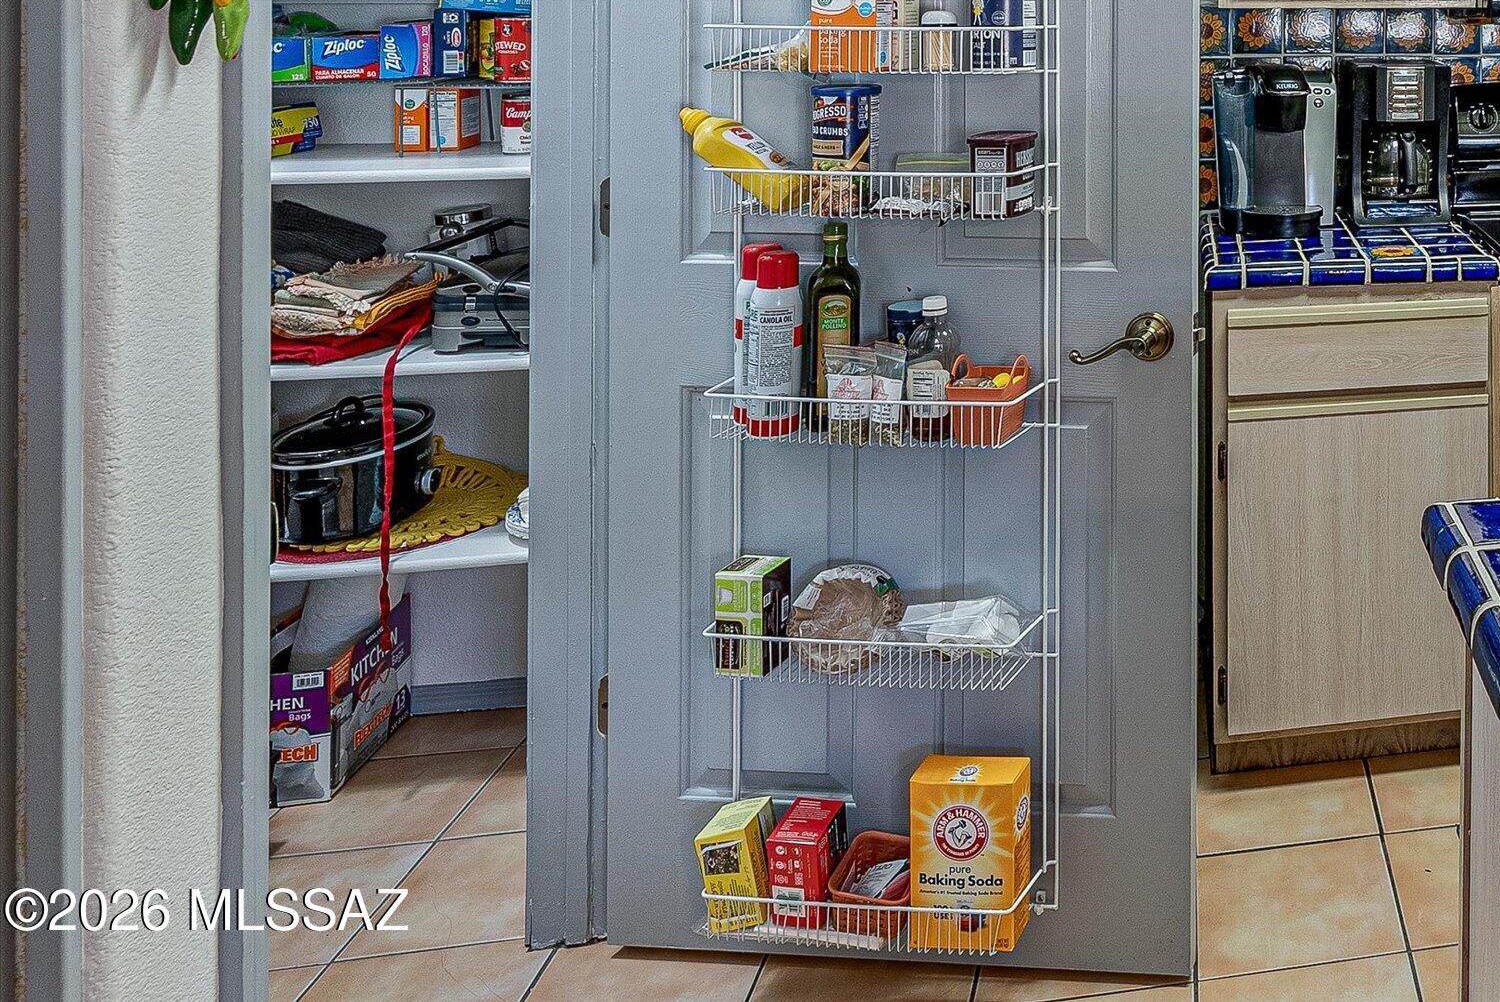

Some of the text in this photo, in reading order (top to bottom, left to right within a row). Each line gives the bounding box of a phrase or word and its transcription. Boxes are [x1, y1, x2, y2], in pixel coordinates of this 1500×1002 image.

[323, 39, 365, 56] Ziploc
[384, 35, 403, 71] Ziploc
[291, 73, 304, 81] 125
[366, 70, 377, 78] 50
[1275, 82, 1299, 90] KEURIG
[819, 126, 849, 137] CRUMBS
[760, 316, 783, 324] CANOLA
[350, 627, 398, 687] KITCHN
[288, 712, 312, 722] Bags
[936, 809, 986, 838] ARM & HAMMER
[949, 866, 972, 875] pure
[919, 873, 1004, 889] Baking Soda
